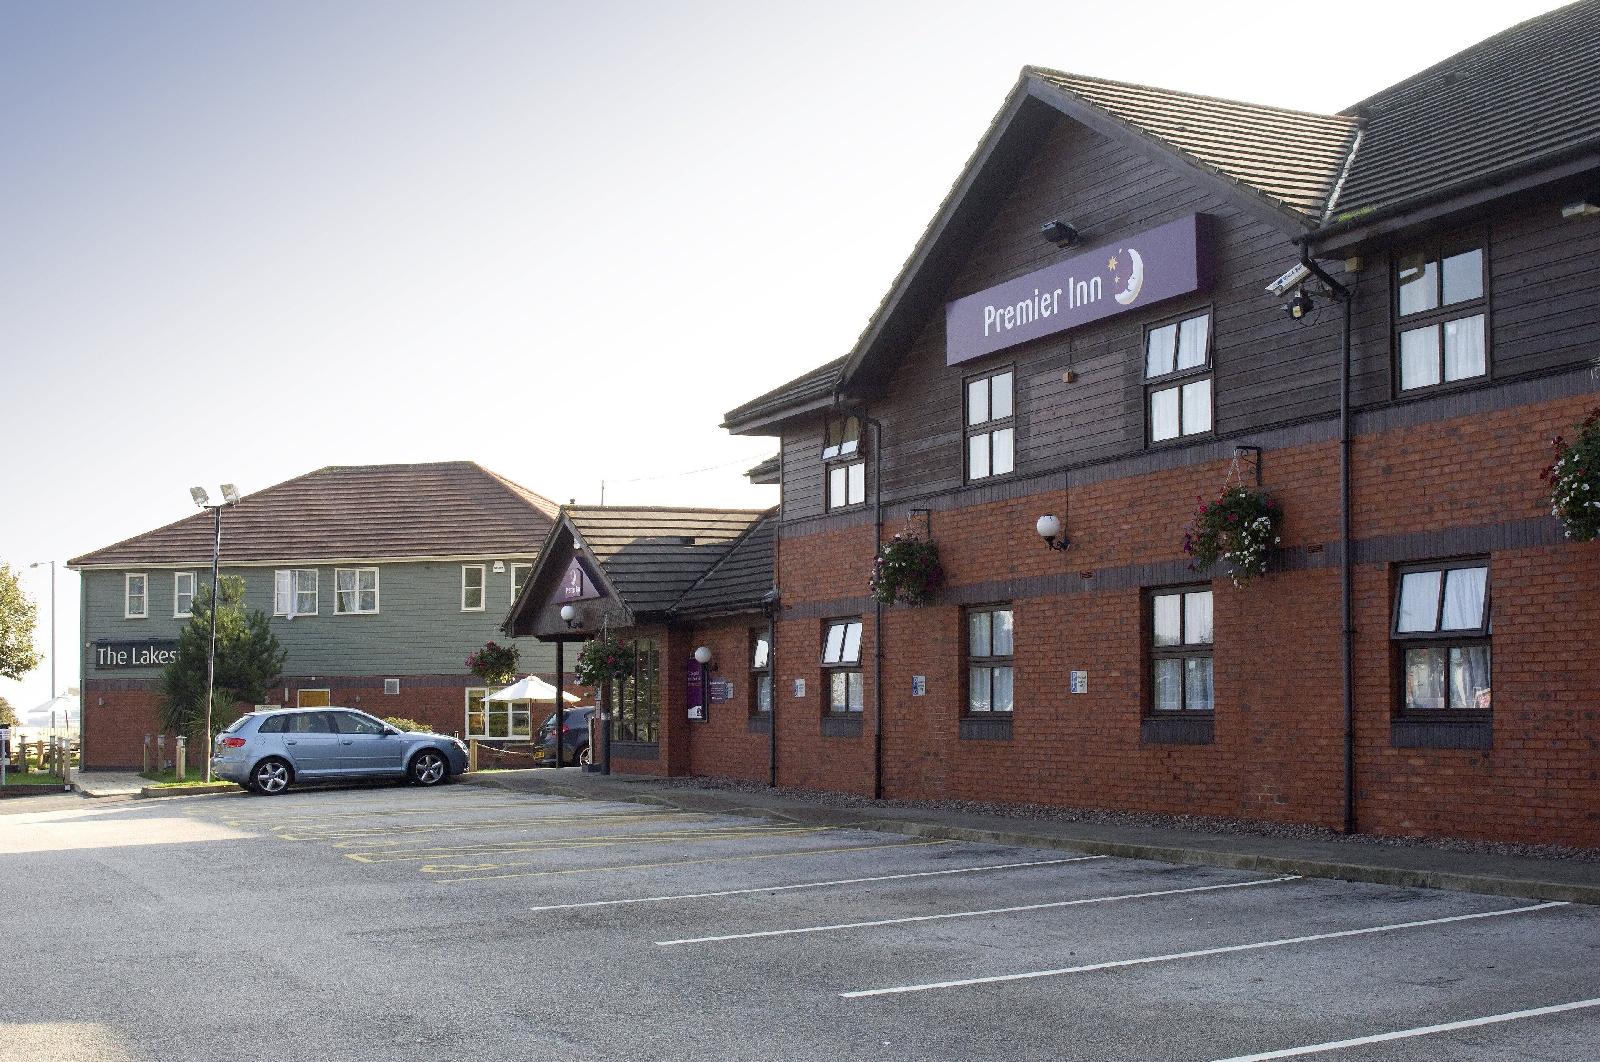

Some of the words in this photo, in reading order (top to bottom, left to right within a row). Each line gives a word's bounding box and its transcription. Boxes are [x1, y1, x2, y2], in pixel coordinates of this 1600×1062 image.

[984, 288, 1063, 337] Premier
[1068, 276, 1102, 310] Inn
[97, 646, 127, 665] The
